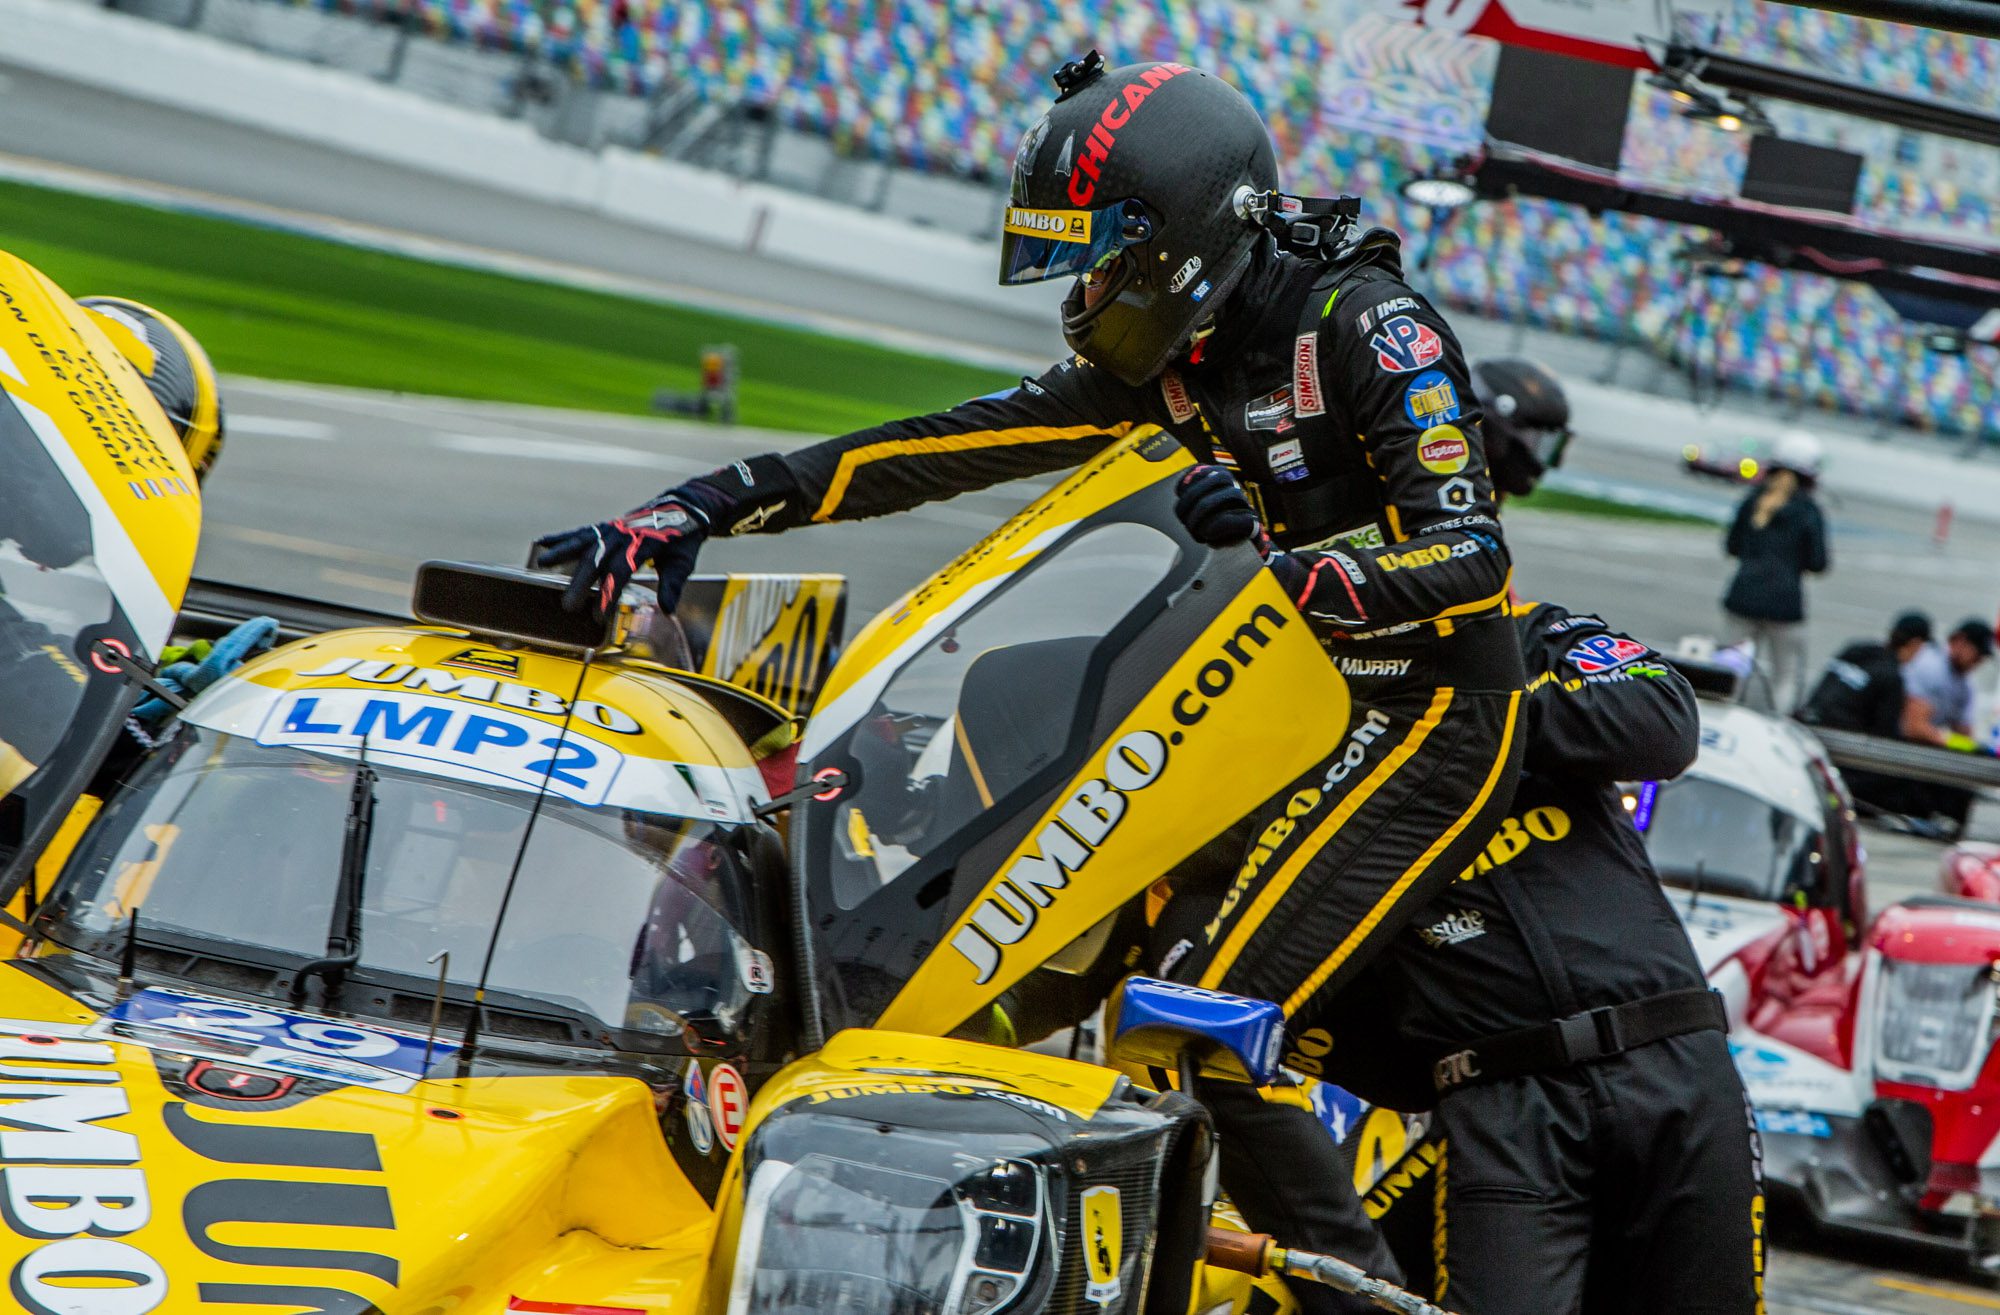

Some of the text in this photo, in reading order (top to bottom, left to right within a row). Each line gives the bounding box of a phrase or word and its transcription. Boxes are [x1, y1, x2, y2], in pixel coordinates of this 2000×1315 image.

[1067, 62, 1191, 207] CHICANE
[1011, 209, 1066, 232] JUMBO
[1370, 315, 1422, 371] VP
[1300, 342, 1319, 408] SIMPSON
[27, 332, 68, 381] DER
[67, 391, 134, 475] GARDE
[1422, 443, 1464, 460] Lipton
[1341, 657, 1412, 676] MURRY
[1566, 634, 1618, 670] VP
[297, 657, 646, 735] JUMBO
[282, 698, 600, 790] LMP2
[949, 602, 1290, 986] JUMBO.com
[151, 1001, 400, 1058] 29
[719, 1082, 741, 1134] E
[808, 1083, 1067, 1122] JUMBO.com
